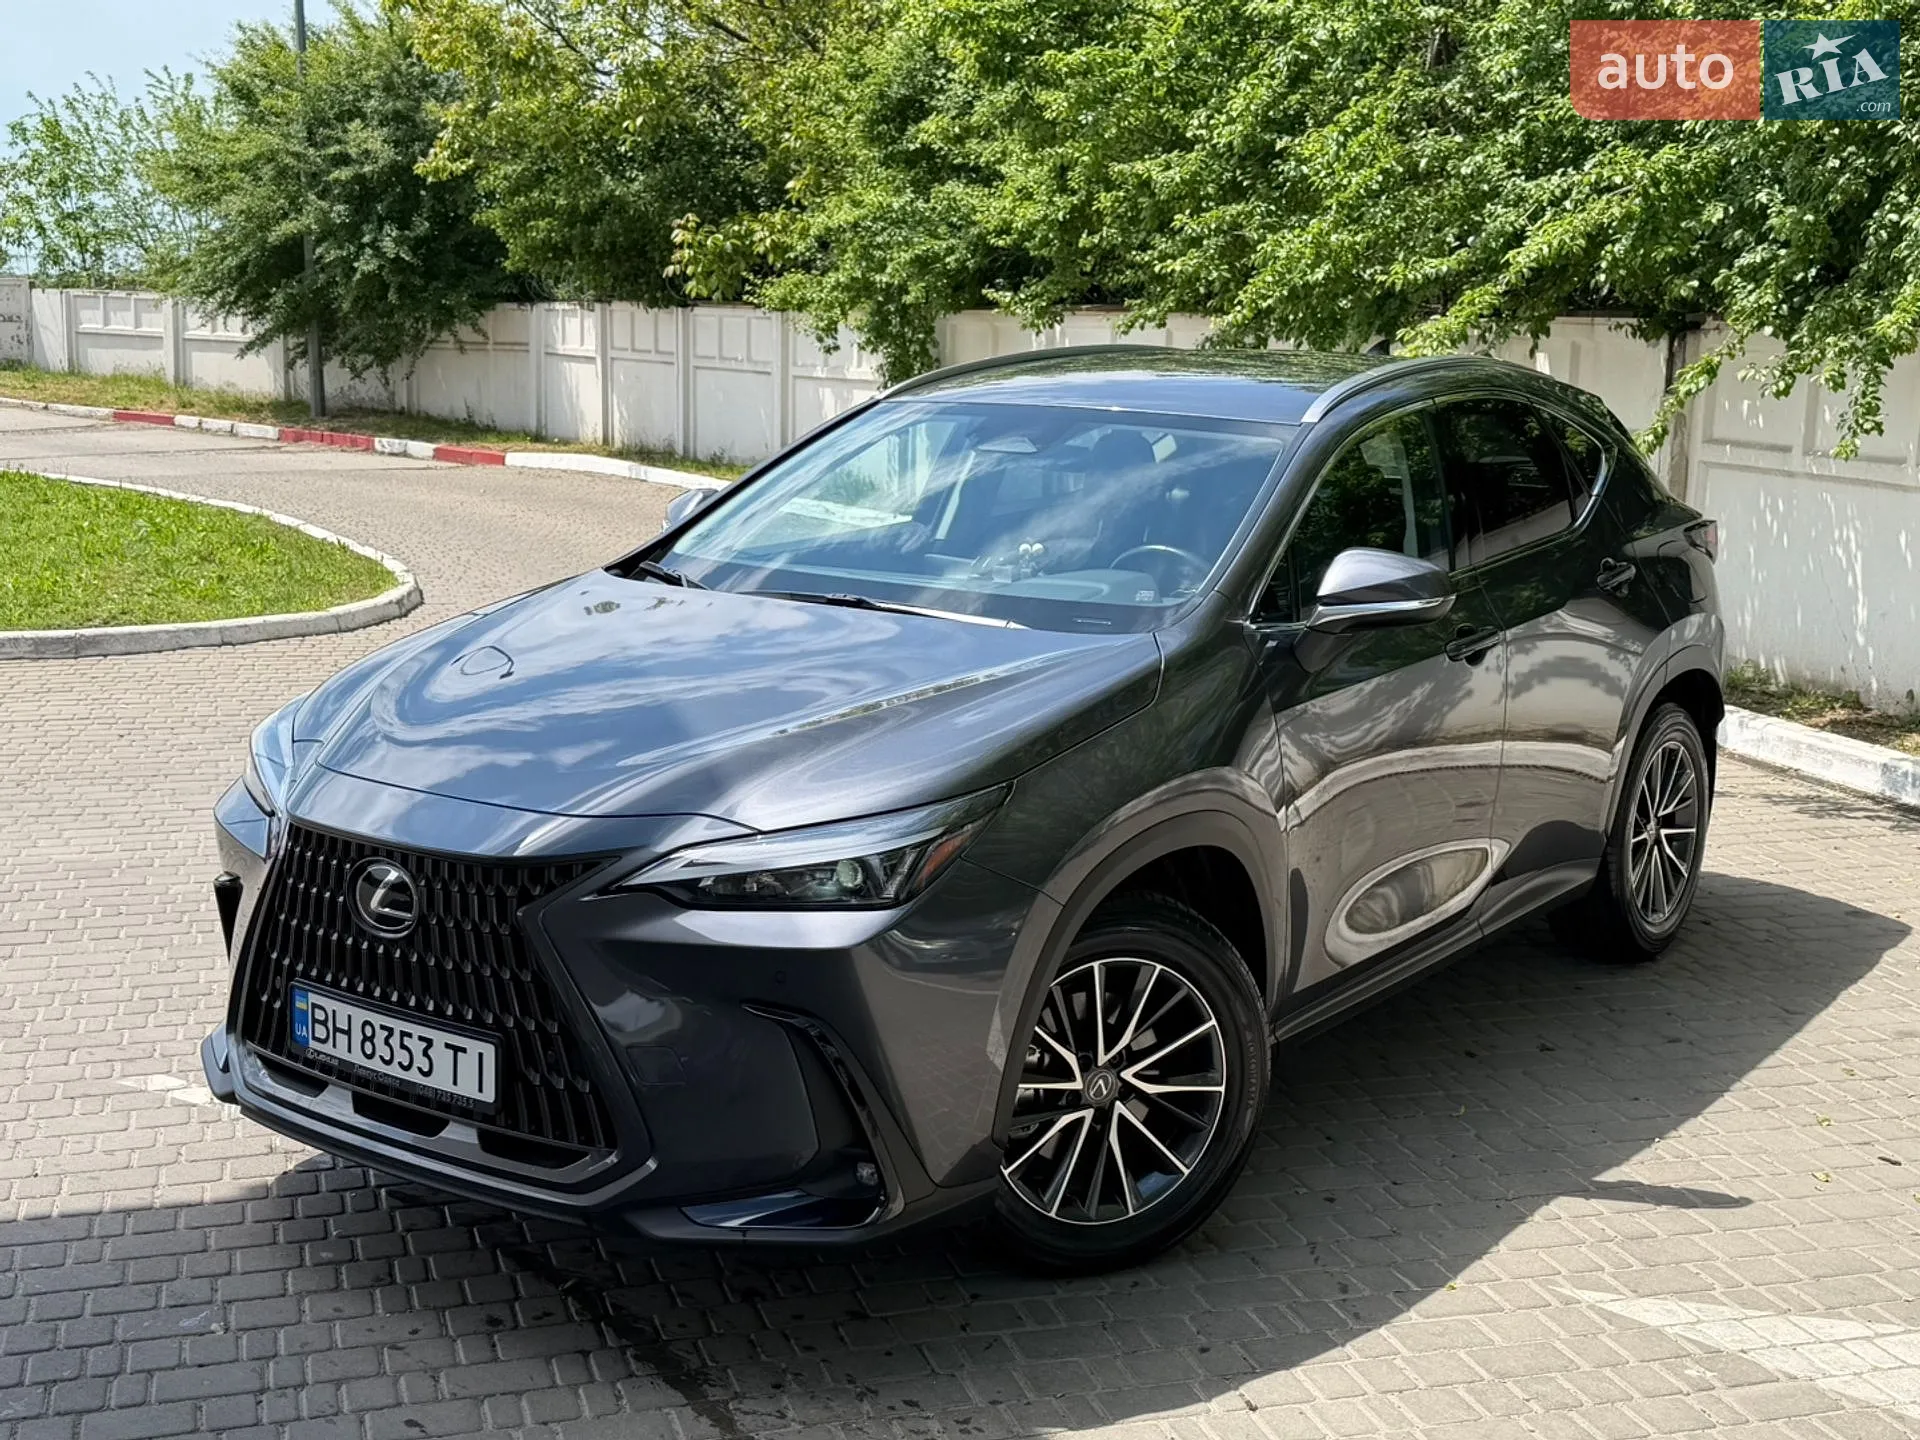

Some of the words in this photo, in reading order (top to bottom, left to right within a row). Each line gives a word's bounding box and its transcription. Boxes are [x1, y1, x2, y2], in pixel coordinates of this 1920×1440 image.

[295, 1023, 308, 1038] UA
[310, 1002, 352, 1054] BH
[360, 1019, 434, 1078] 8353
[444, 1042, 484, 1094] TI
